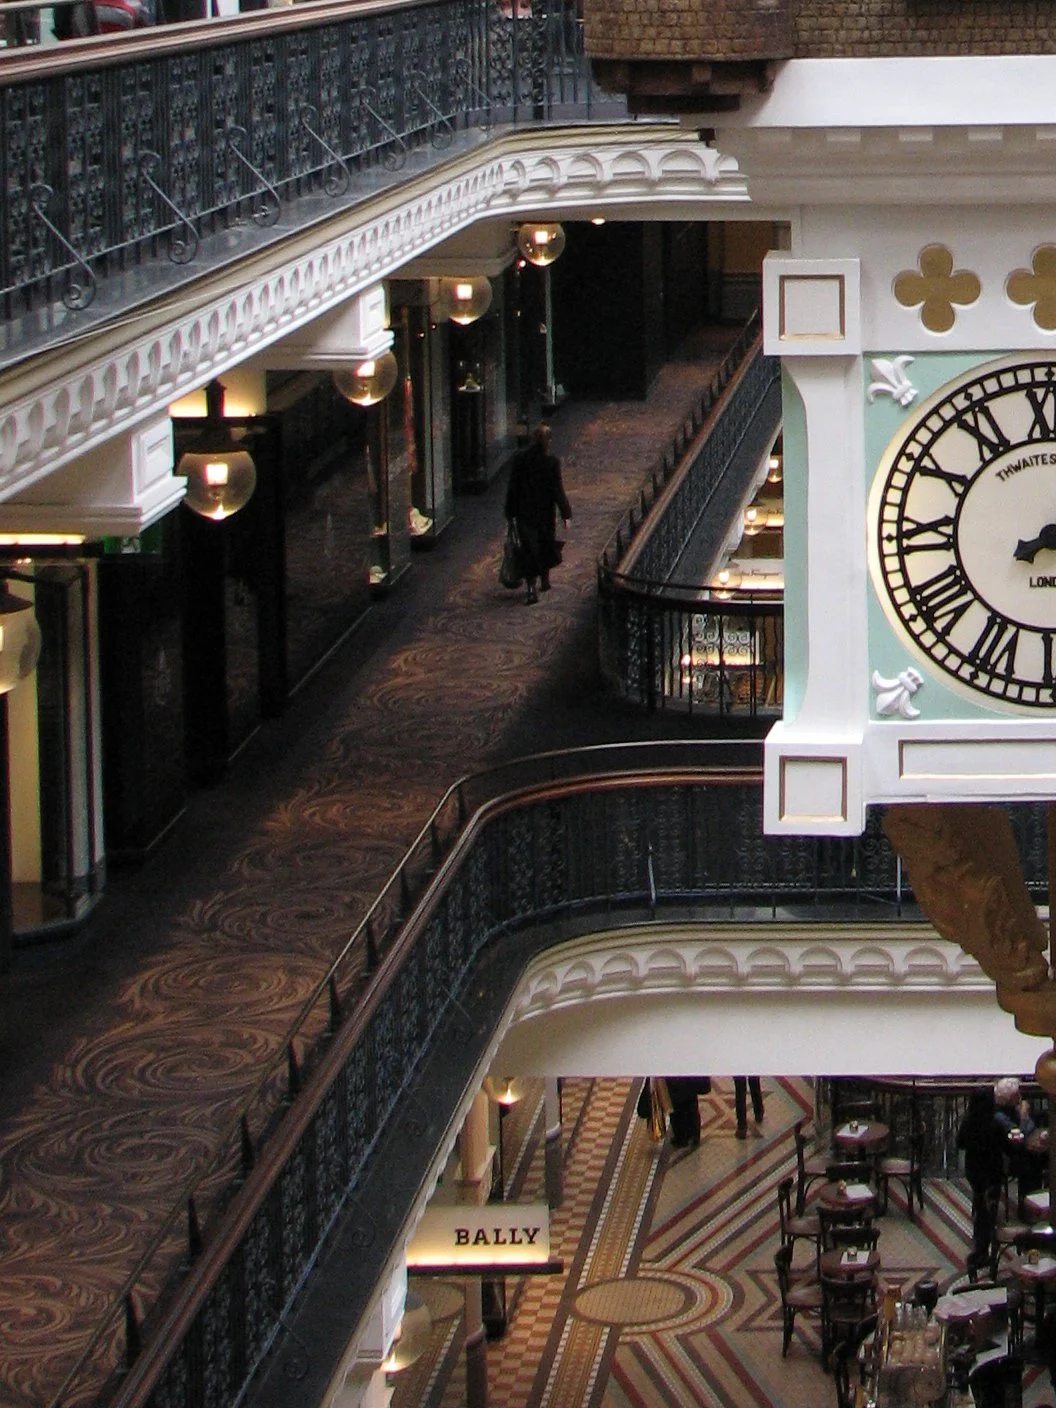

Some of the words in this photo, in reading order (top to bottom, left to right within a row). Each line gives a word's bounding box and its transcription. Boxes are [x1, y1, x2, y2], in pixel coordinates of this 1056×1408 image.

[956, 403, 1012, 464] XI
[919, 452, 969, 496] X
[902, 515, 955, 555] IX
[912, 564, 976, 636] VIII
[968, 612, 1020, 675] VII
[454, 1228, 540, 1246] BALLY
